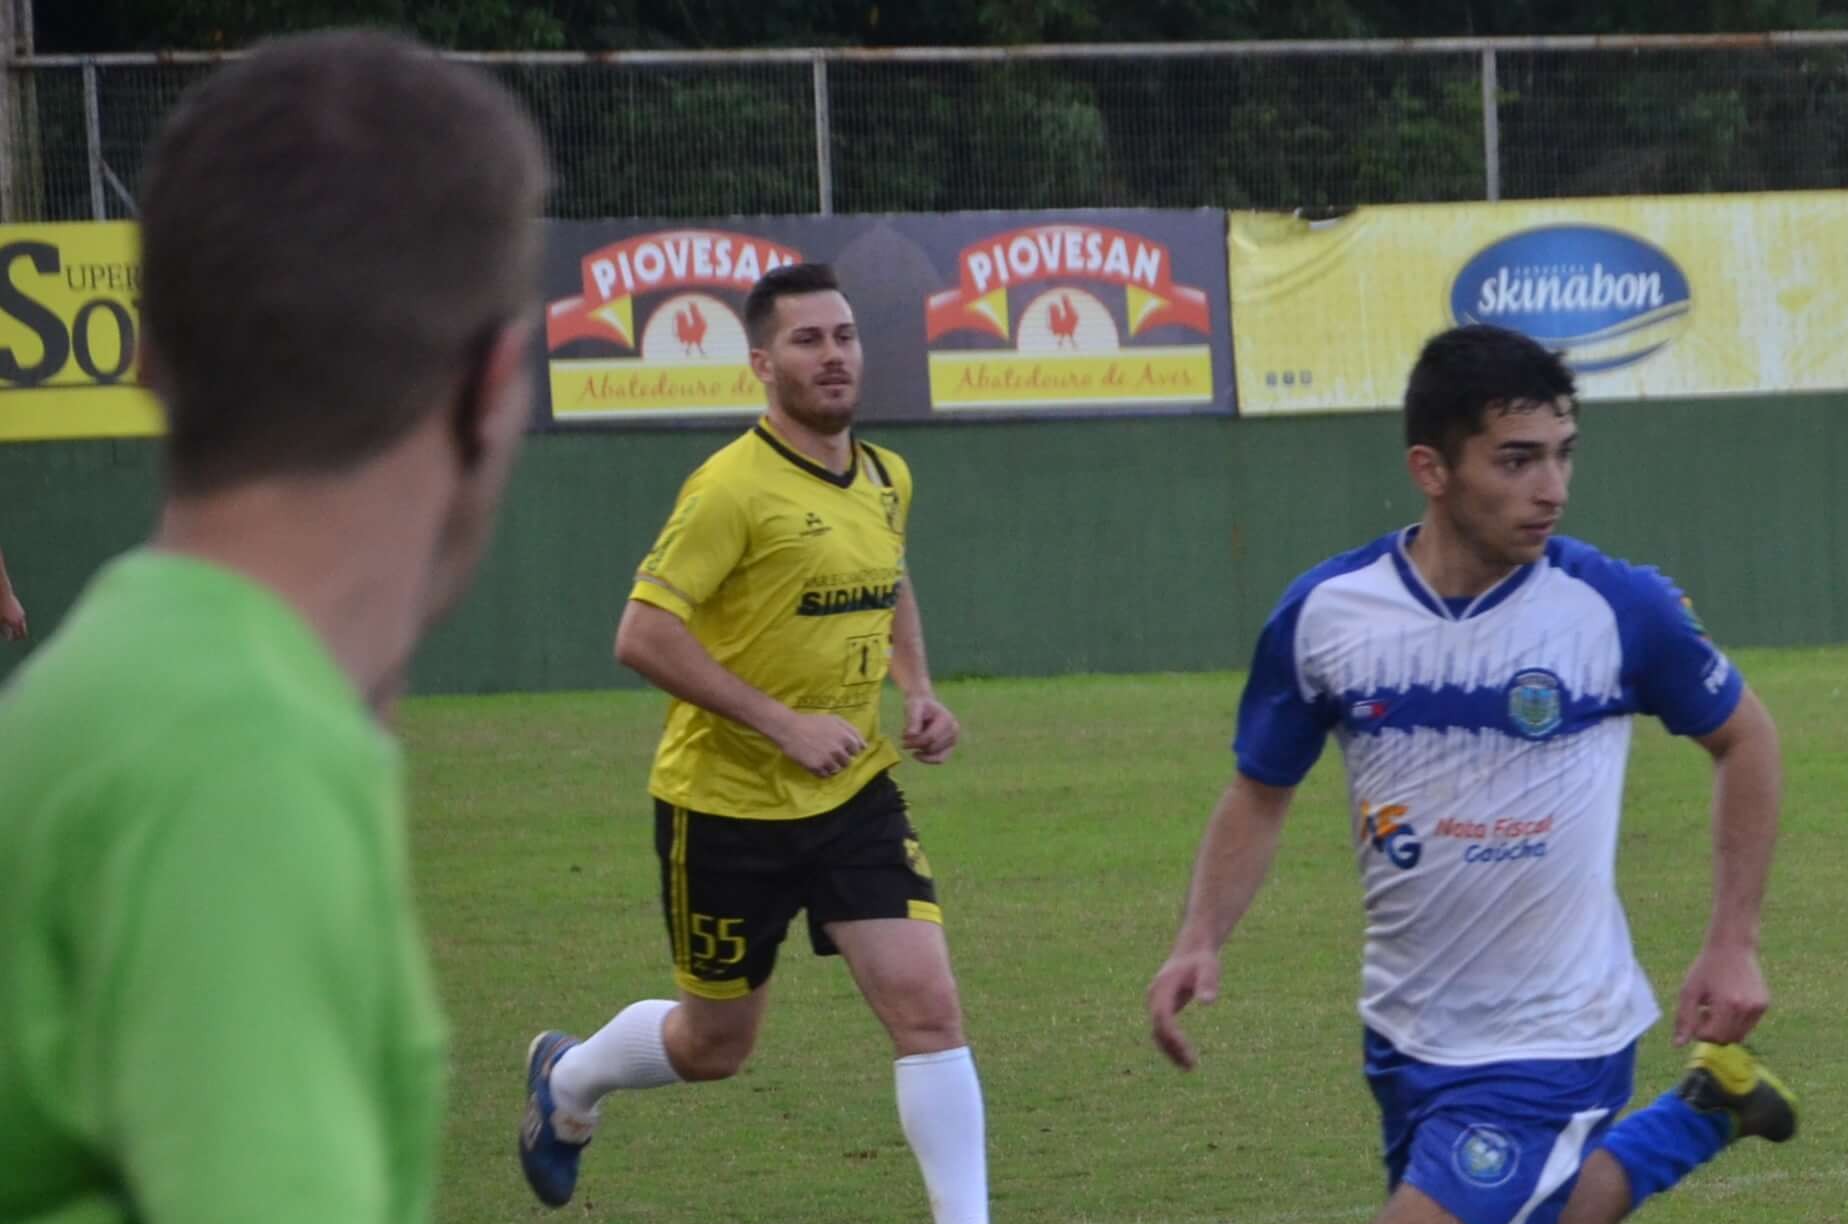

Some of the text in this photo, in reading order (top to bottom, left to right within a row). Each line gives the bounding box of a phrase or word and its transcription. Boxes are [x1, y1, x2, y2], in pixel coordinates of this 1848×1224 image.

[967, 235, 1162, 291] PIOVESAN
[1478, 263, 1665, 314] skinabon
[691, 913, 747, 964] 55
